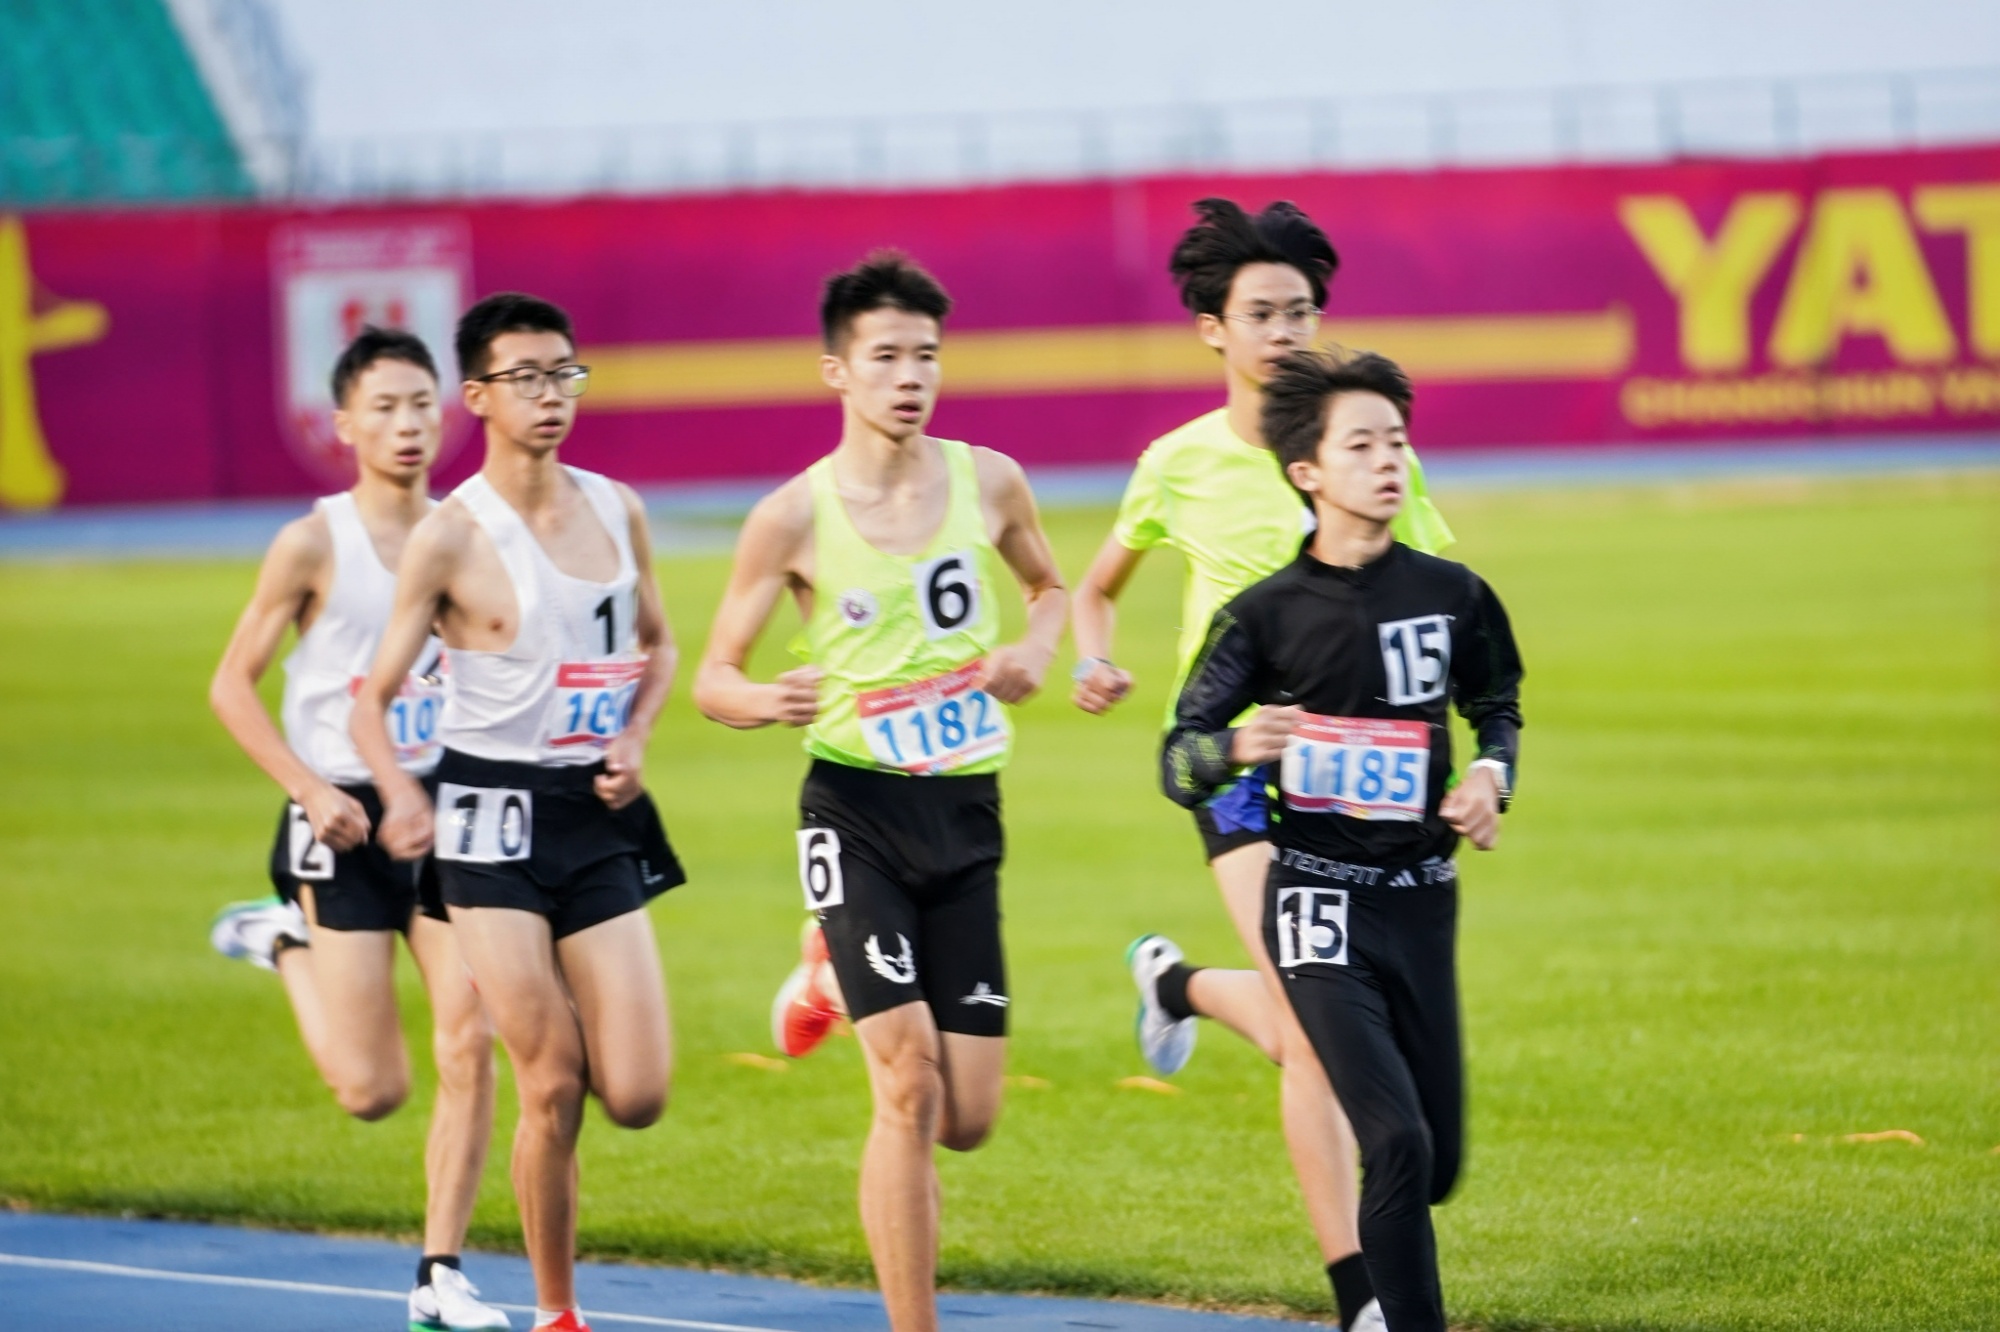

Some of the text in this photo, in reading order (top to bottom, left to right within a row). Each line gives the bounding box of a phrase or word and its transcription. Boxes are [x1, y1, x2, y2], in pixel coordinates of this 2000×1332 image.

[928, 558, 972, 629] 6
[1387, 621, 1447, 698] 15
[391, 696, 444, 744] 10
[877, 689, 999, 764] 1182
[1298, 744, 1418, 803] 1185
[453, 792, 526, 858] 10
[808, 831, 832, 904] 6
[1281, 848, 1386, 886] TECHFIT
[1279, 891, 1344, 961] 15
